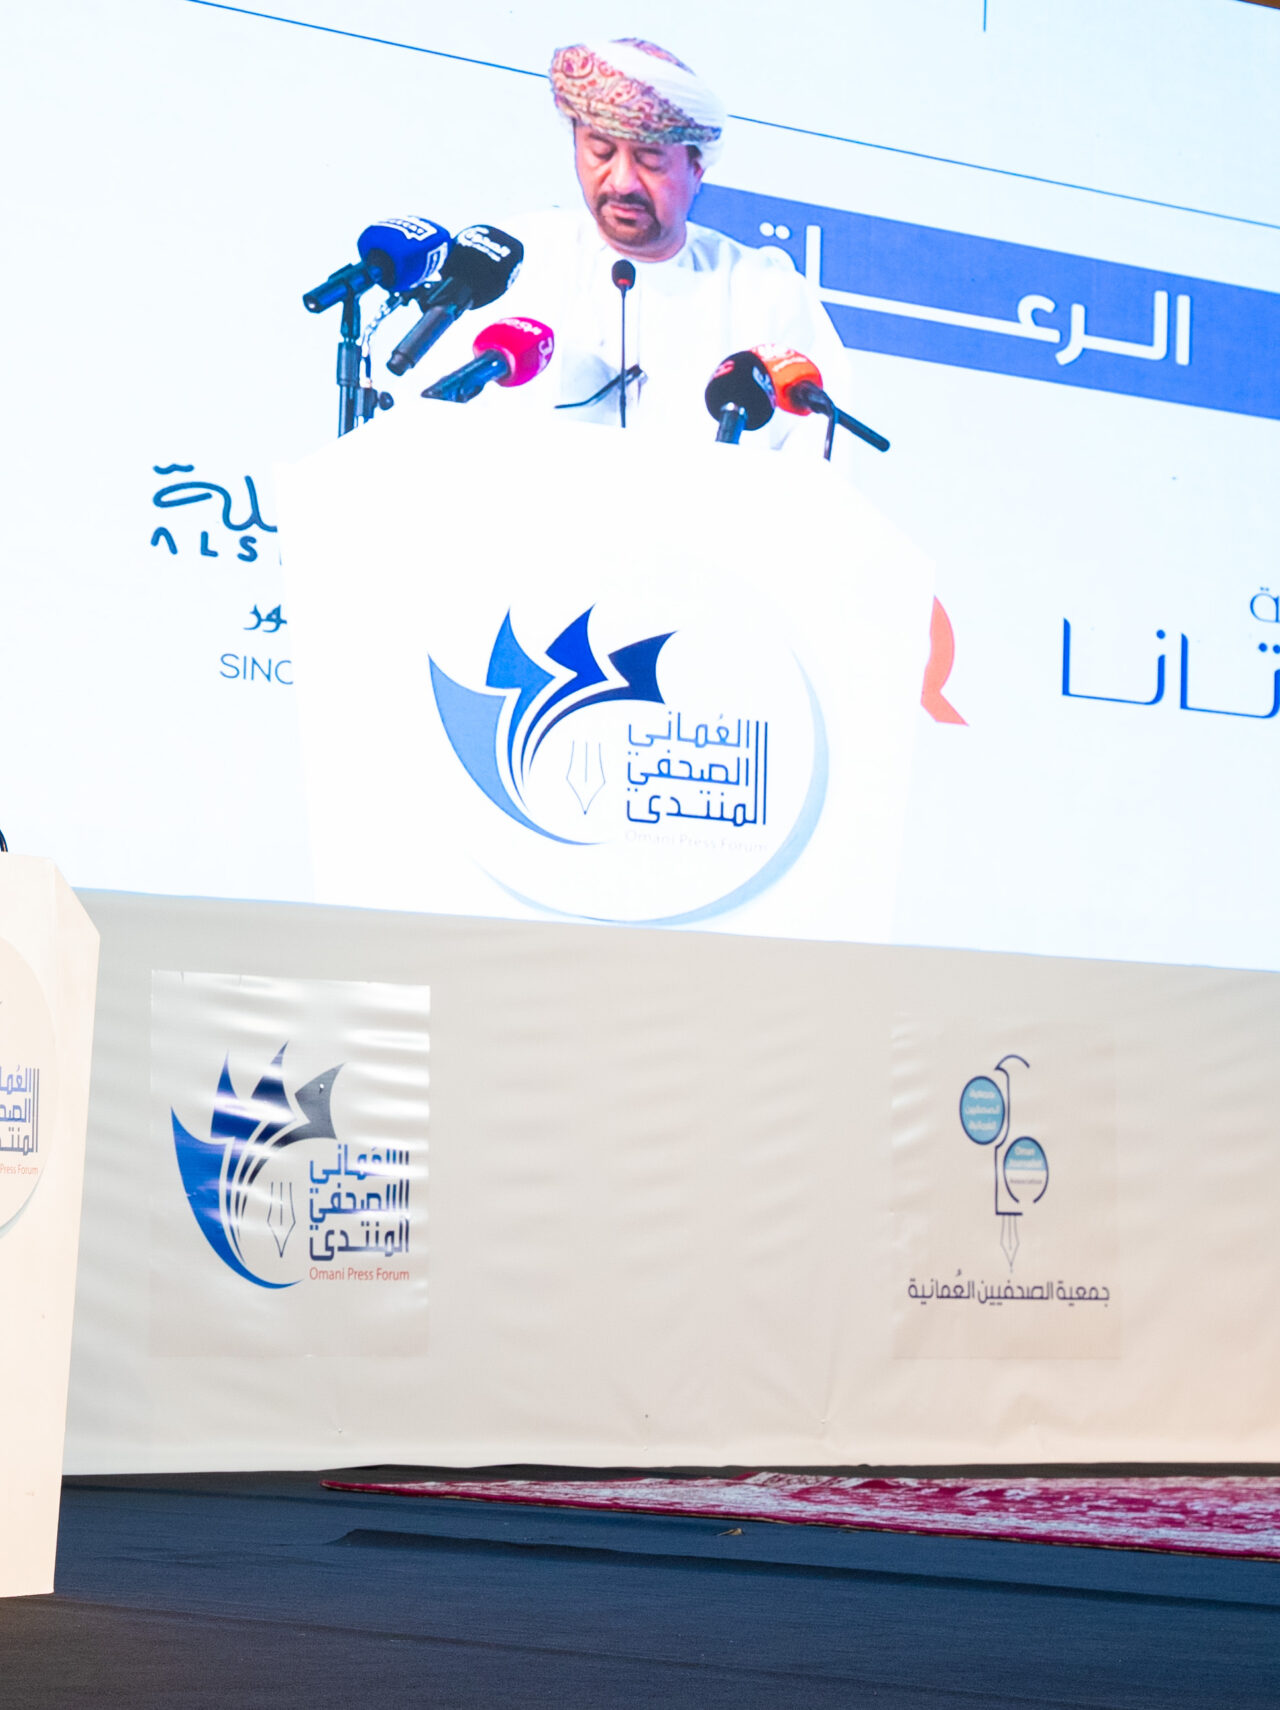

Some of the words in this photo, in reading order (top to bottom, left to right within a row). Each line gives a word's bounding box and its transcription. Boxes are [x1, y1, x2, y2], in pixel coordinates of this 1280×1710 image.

[220, 653, 294, 685] SINC
[0, 1163, 16, 1174] Press
[18, 1164, 39, 1176] Forum
[309, 1266, 345, 1281] Omani
[347, 1267, 374, 1281] Press
[376, 1267, 410, 1281] Forum
[977, 1280, 1054, 1306] الصحفيين
[1055, 1281, 1111, 1307] جمعية
